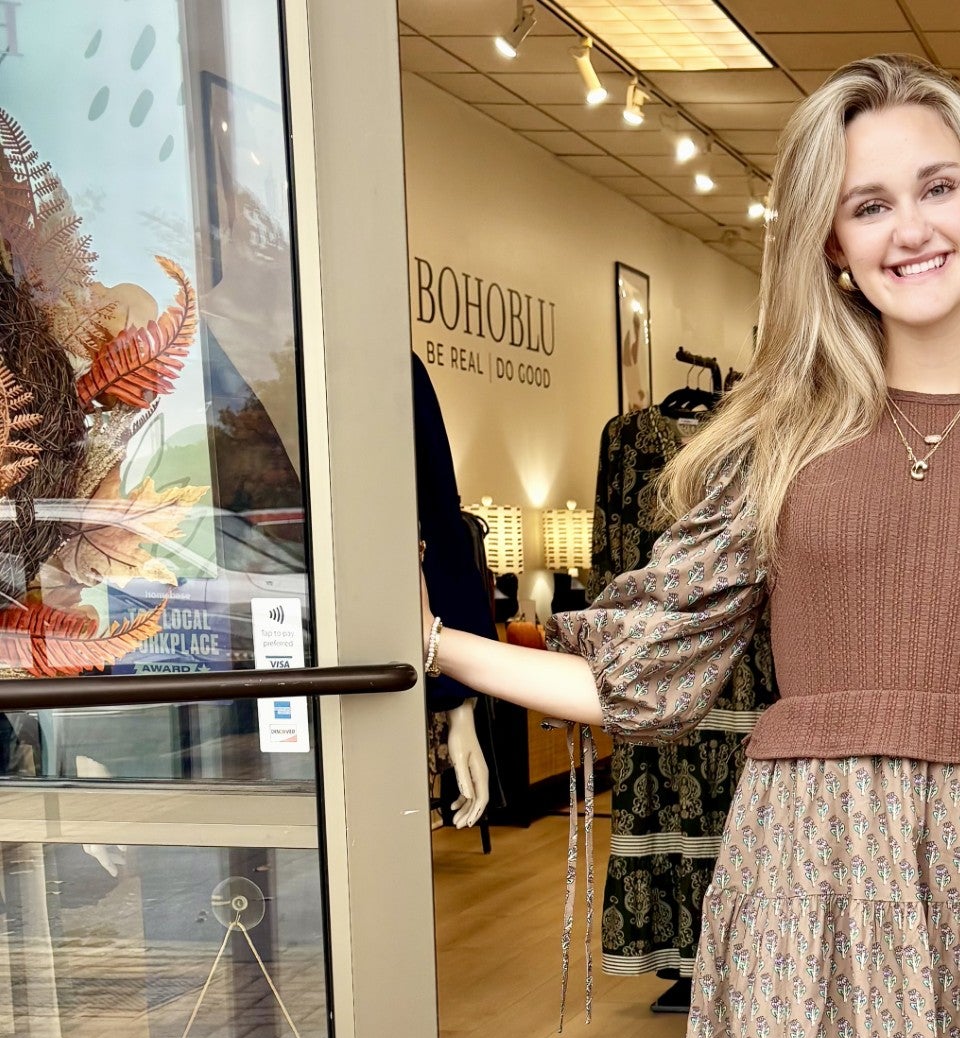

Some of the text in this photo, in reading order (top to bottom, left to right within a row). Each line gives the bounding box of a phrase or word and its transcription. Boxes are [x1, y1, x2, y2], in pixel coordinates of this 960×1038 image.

[414, 256, 555, 356] BOHOBLU
[427, 341, 551, 389] BE REAL DO GOOD
[163, 608, 211, 631] LOCAL
[138, 632, 220, 656] ORKPLACE
[142, 663, 191, 673] AWARD
[269, 660, 290, 669] VISA
